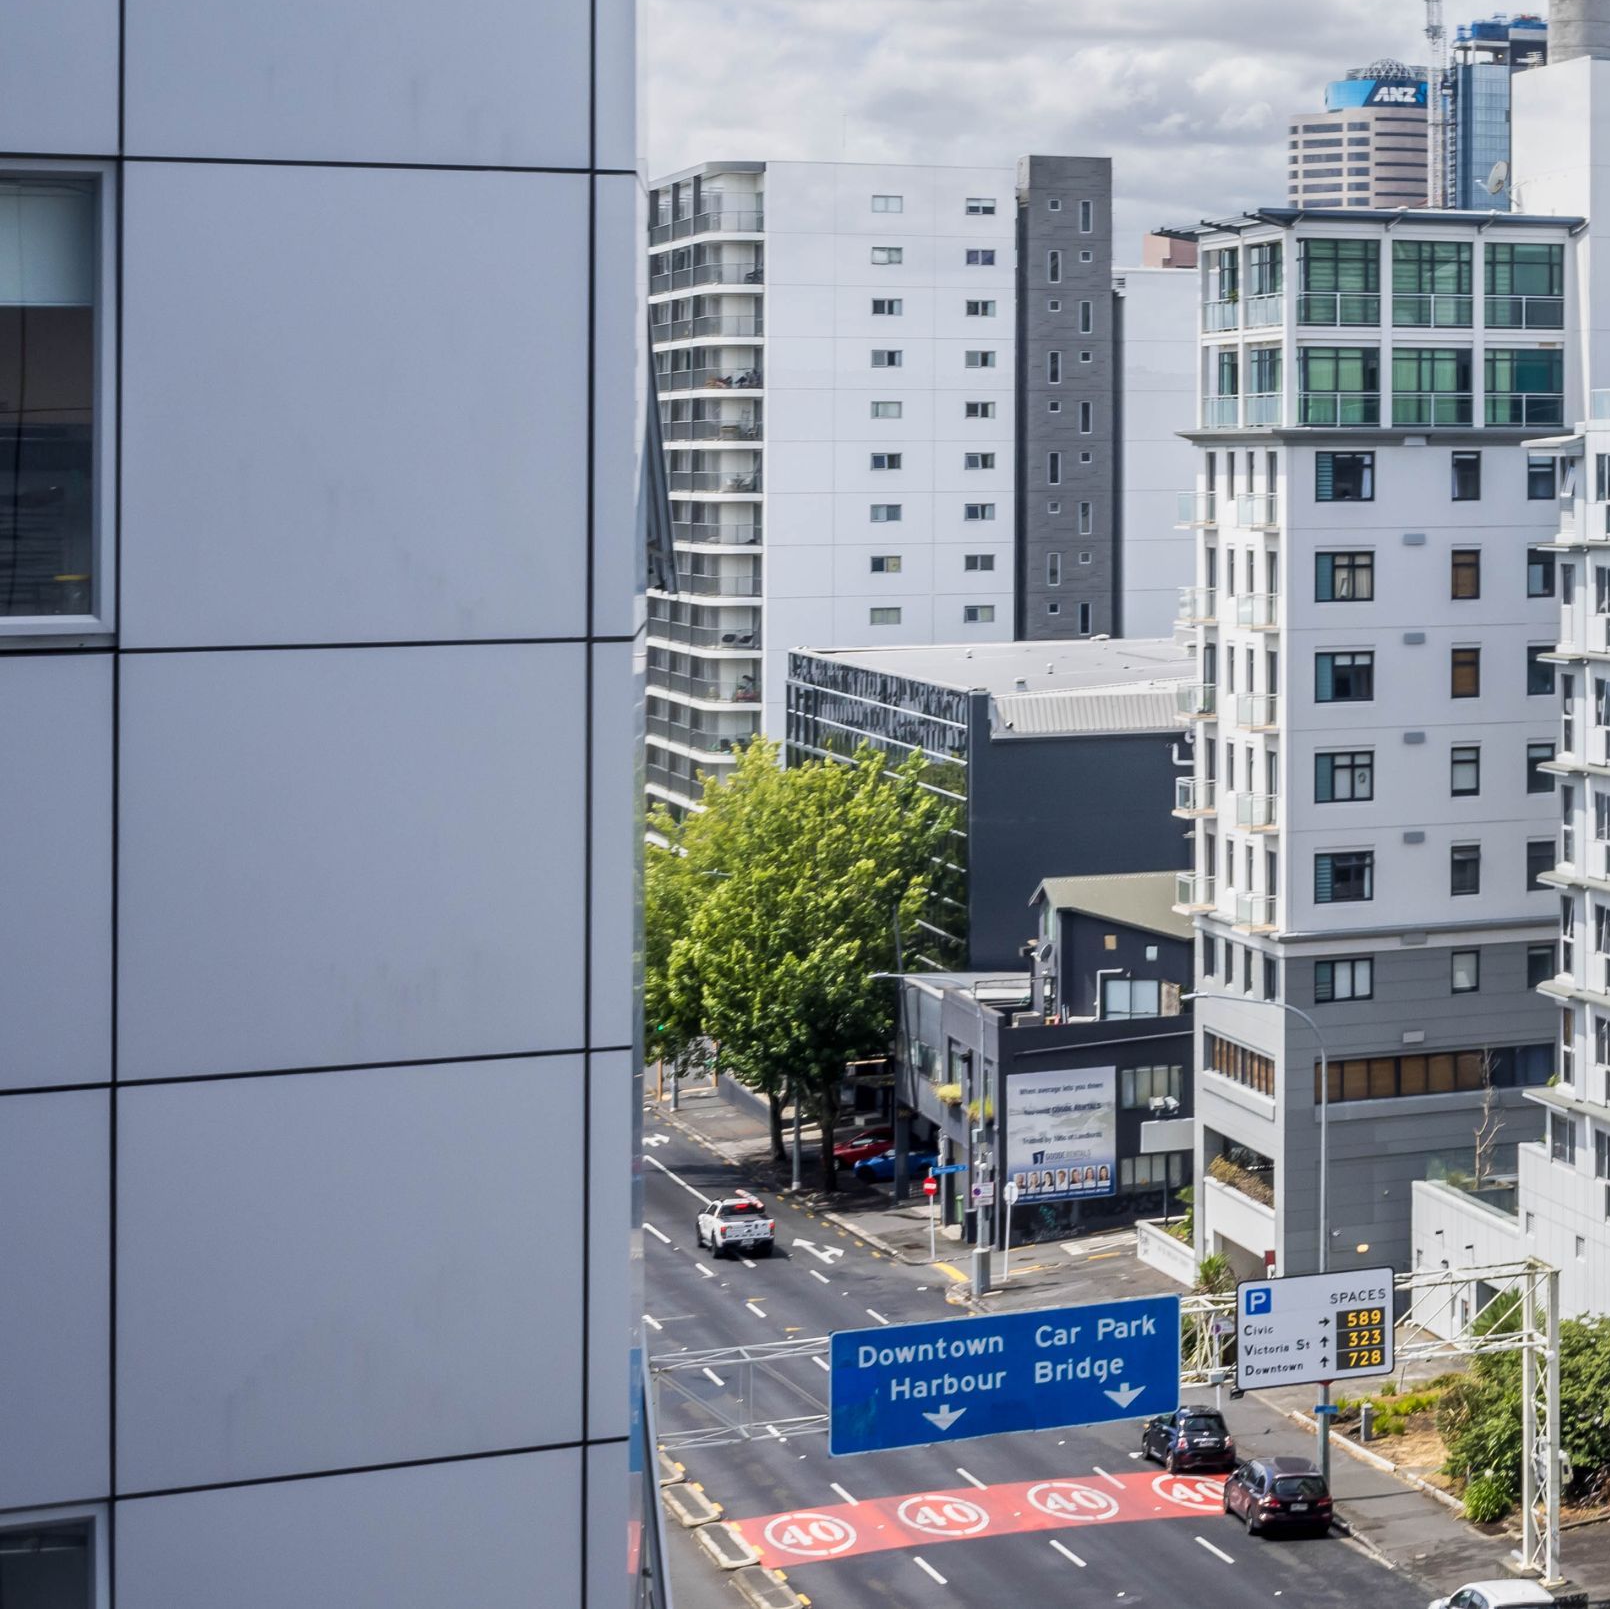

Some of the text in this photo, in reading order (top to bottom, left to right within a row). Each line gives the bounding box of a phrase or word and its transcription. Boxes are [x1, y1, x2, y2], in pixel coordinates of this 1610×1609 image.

[1373, 86, 1417, 103] ANZ
[1250, 1291, 1267, 1312] P
[1329, 1288, 1387, 1304] SPACES
[1244, 1324, 1274, 1336] Civic
[1347, 1309, 1382, 1327] 589
[858, 1314, 1156, 1368] Downtown Car Park
[1244, 1329, 1382, 1356] Victoria St 323
[1245, 1349, 1382, 1376] Downtown 728
[891, 1356, 1125, 1401] Harbour Bridge
[1046, 1490, 1108, 1511] 40
[915, 1502, 979, 1526] 40
[782, 1520, 845, 1546] 40
